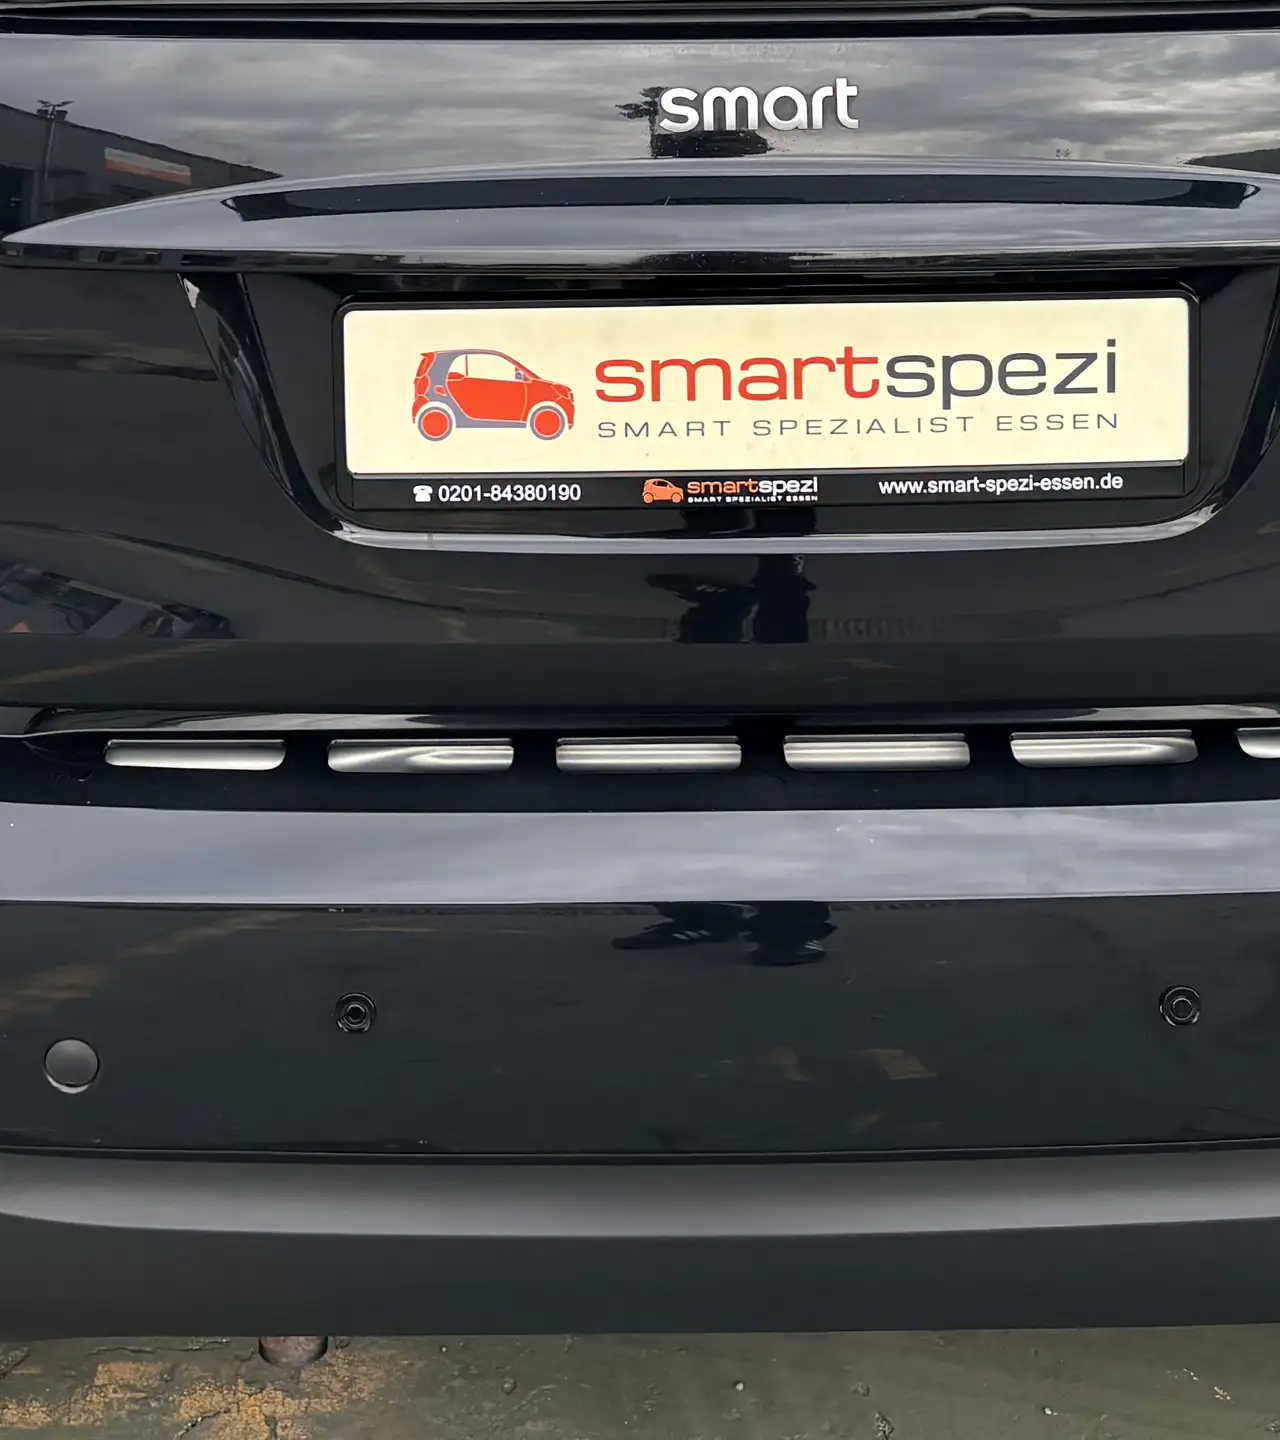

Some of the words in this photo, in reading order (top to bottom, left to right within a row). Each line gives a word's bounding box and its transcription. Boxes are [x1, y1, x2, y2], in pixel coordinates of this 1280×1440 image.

[659, 77, 859, 133] smart
[595, 338, 1117, 410] smartspezi
[597, 420, 732, 438] SMART
[752, 415, 975, 436] SPEZIALIST
[995, 413, 1118, 432] ESSEN
[438, 483, 582, 502] 0201-84380190
[687, 476, 818, 496] smartspezi
[878, 472, 1124, 495] www.smart-spezi-essen.de
[725, 495, 782, 503] SPEZIALIST
[786, 494, 818, 502] ESSEN
